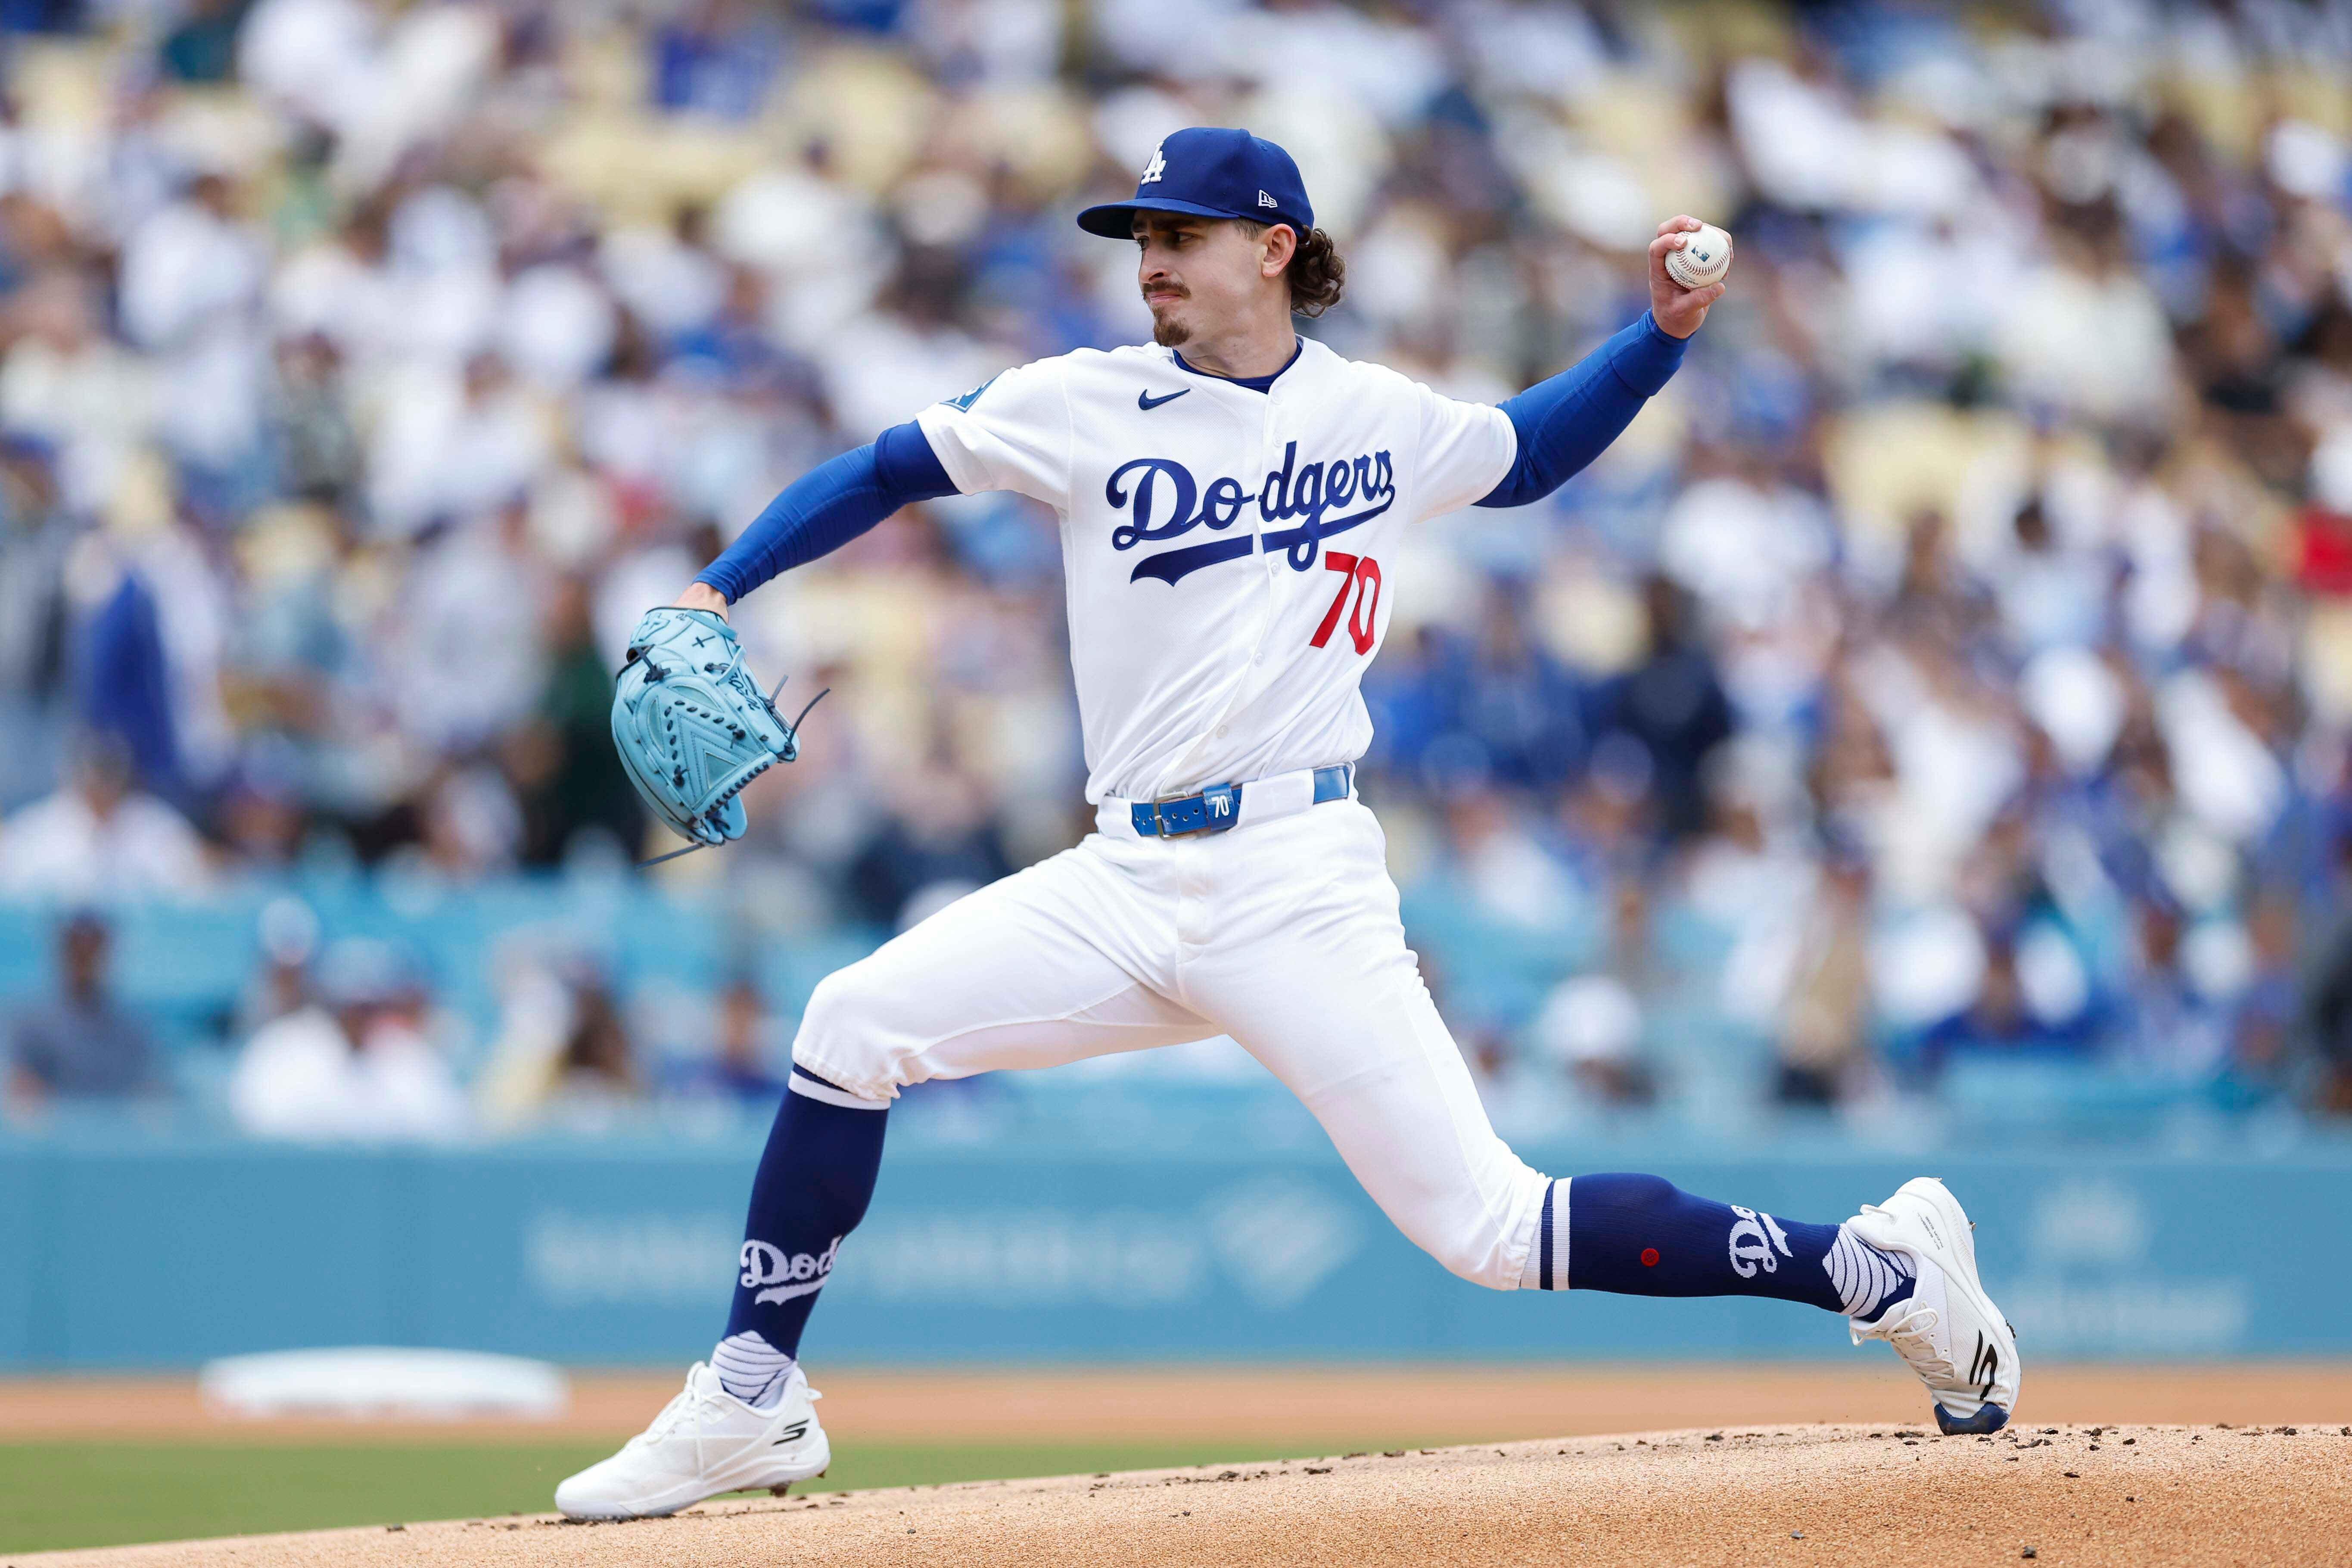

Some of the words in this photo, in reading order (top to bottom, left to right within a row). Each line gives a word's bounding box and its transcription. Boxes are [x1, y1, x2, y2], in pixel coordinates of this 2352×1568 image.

[1141, 141, 1167, 185] LA
[1106, 441, 1395, 572] Dodgers
[1309, 551, 1381, 656] 70
[1211, 795, 1230, 818] 70
